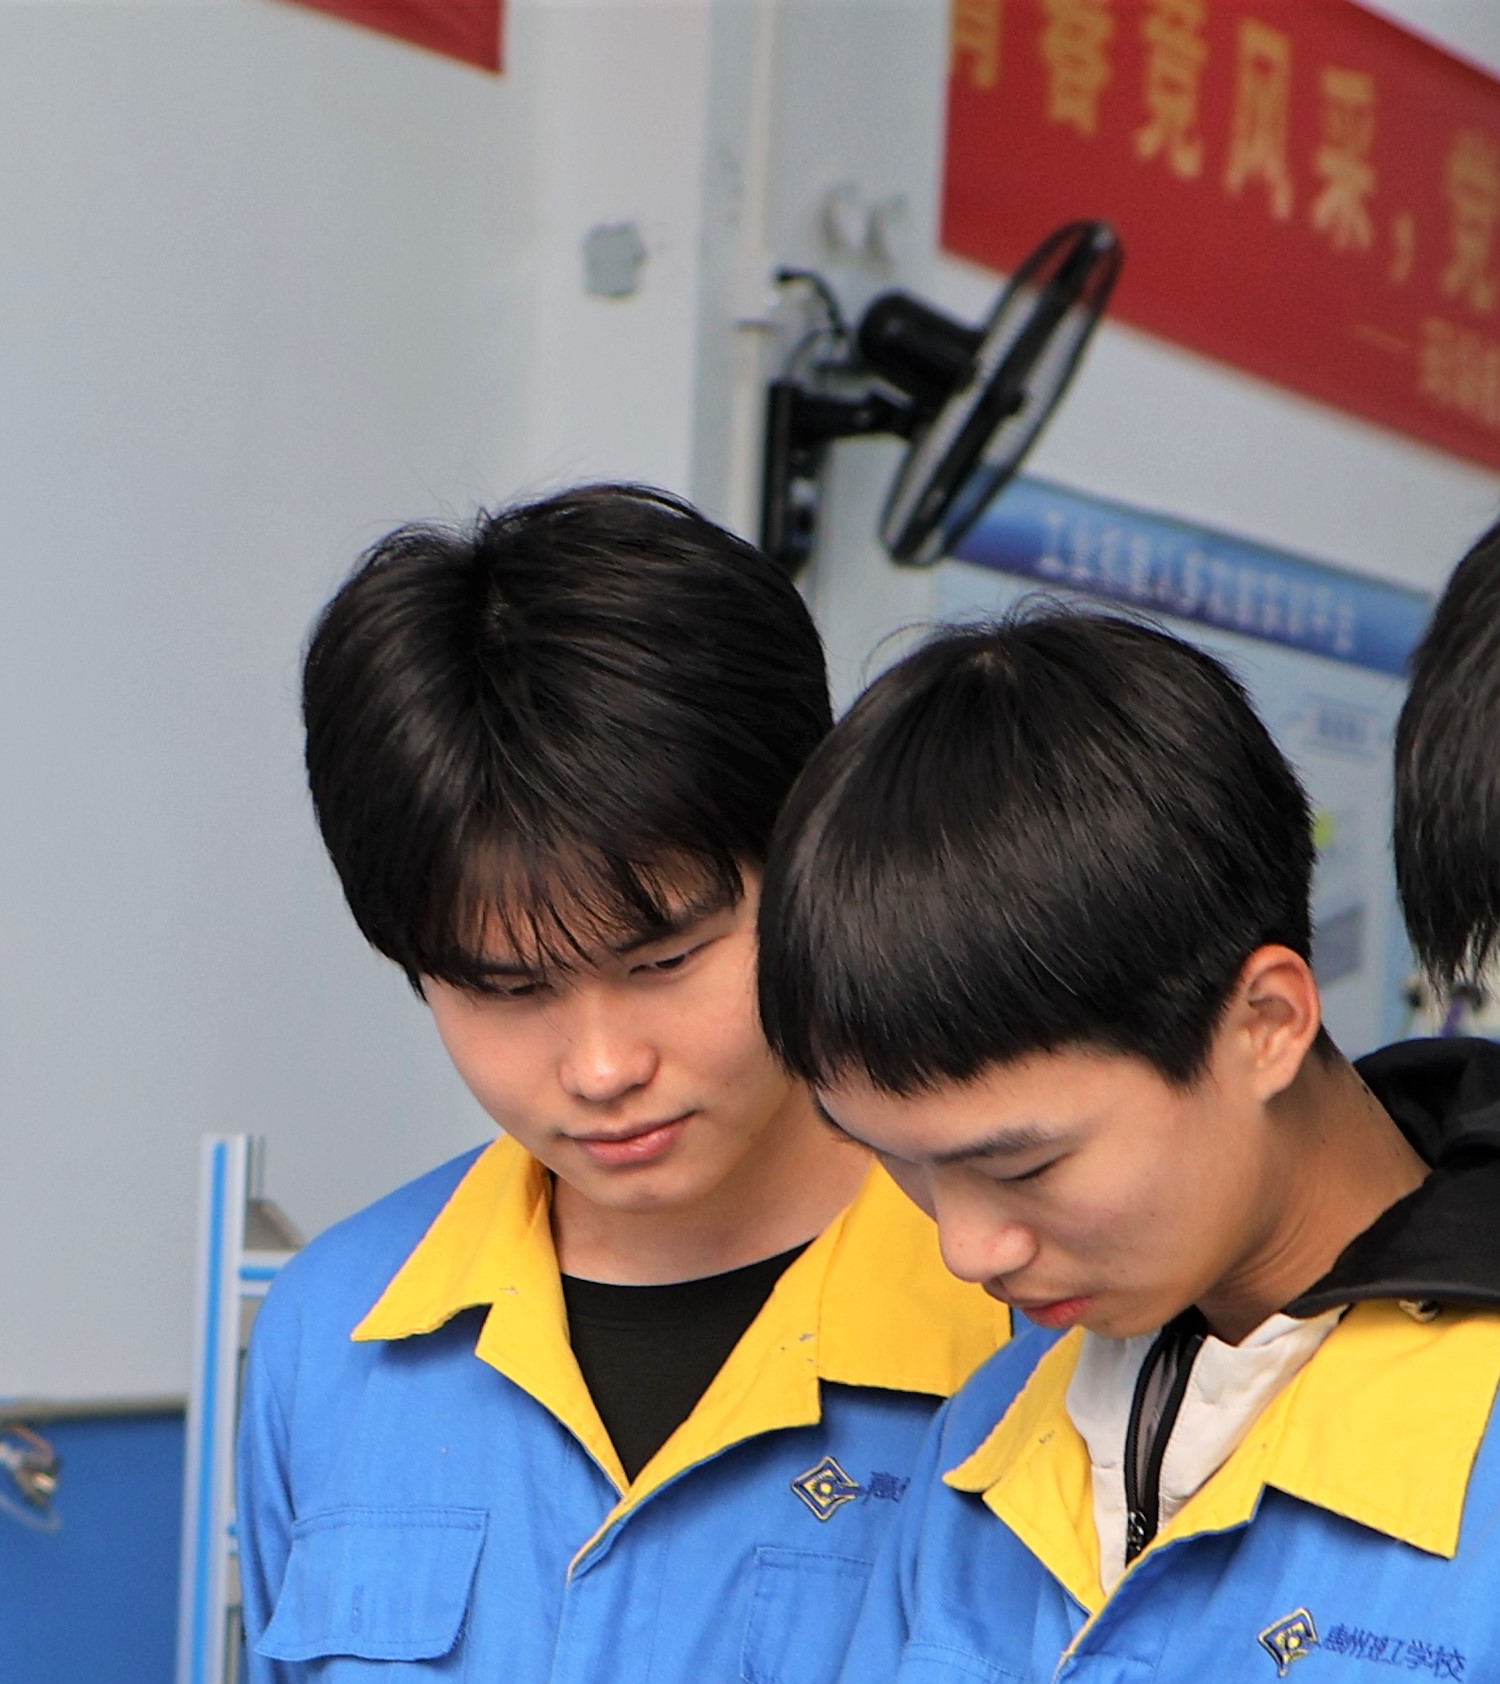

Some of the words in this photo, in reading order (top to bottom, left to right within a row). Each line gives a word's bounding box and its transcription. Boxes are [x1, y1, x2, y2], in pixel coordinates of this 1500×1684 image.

[1324, 1623, 1467, 1682] 惠州理工学校
